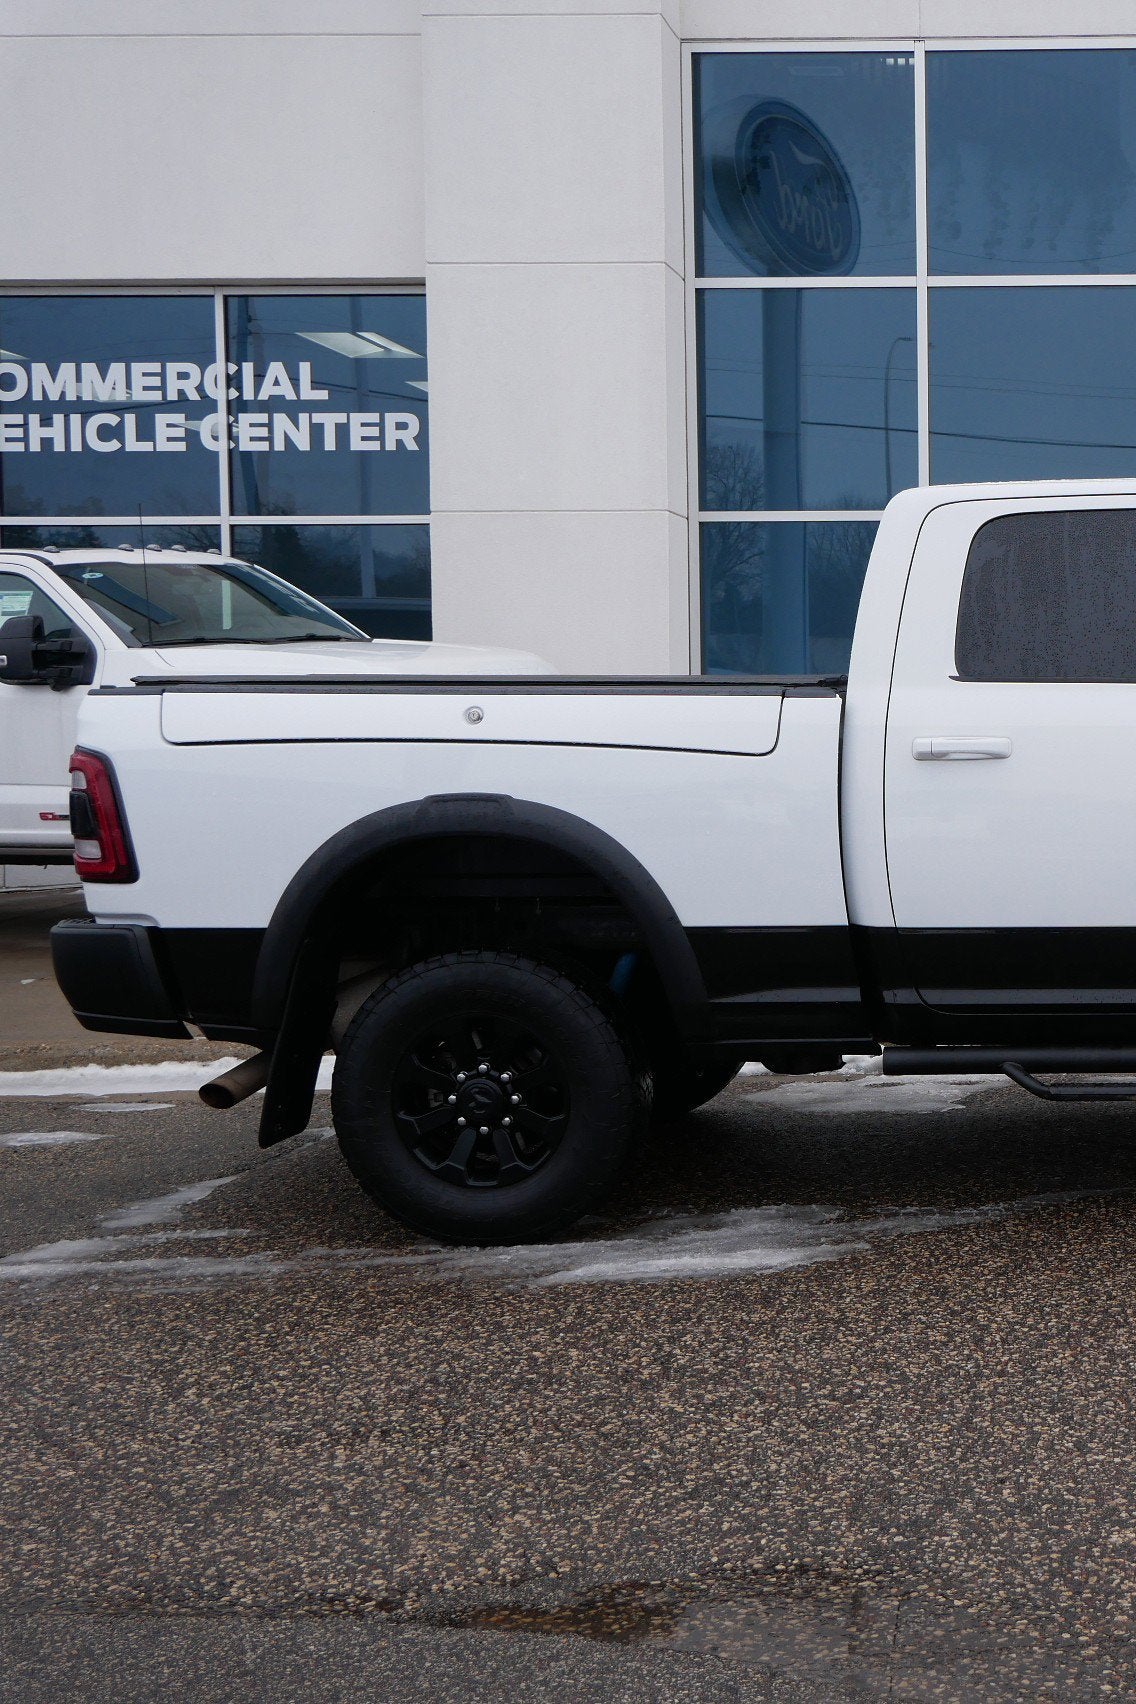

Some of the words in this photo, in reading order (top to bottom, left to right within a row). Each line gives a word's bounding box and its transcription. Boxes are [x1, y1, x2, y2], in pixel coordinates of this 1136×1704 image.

[0, 362, 329, 401] OMMERCIAL
[0, 412, 187, 453] EHICLE
[200, 412, 420, 452] CENTER
